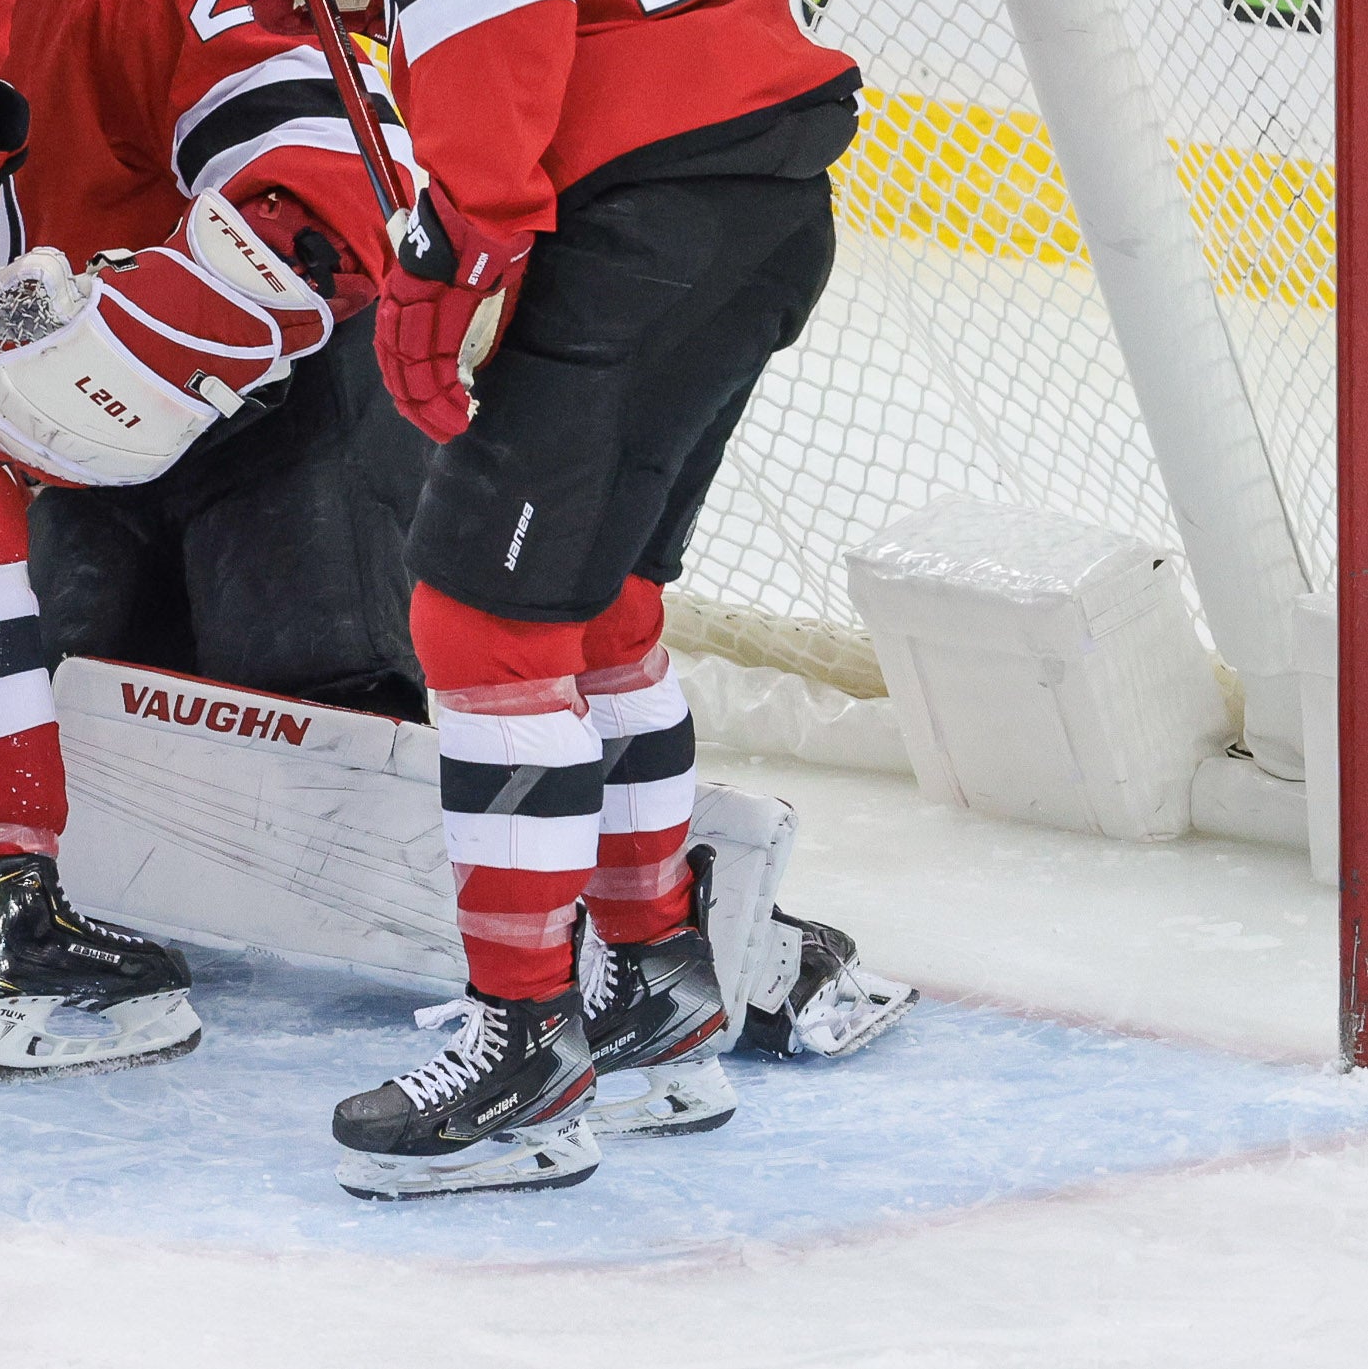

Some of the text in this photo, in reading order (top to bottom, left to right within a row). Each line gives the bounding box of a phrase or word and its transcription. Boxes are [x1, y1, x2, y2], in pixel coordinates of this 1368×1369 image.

[206, 207, 288, 295] TRUE
[74, 374, 143, 429] L20.1
[503, 500, 534, 572] BAUER
[120, 681, 312, 747] VAUGHN
[476, 1093, 519, 1125] BAUER
